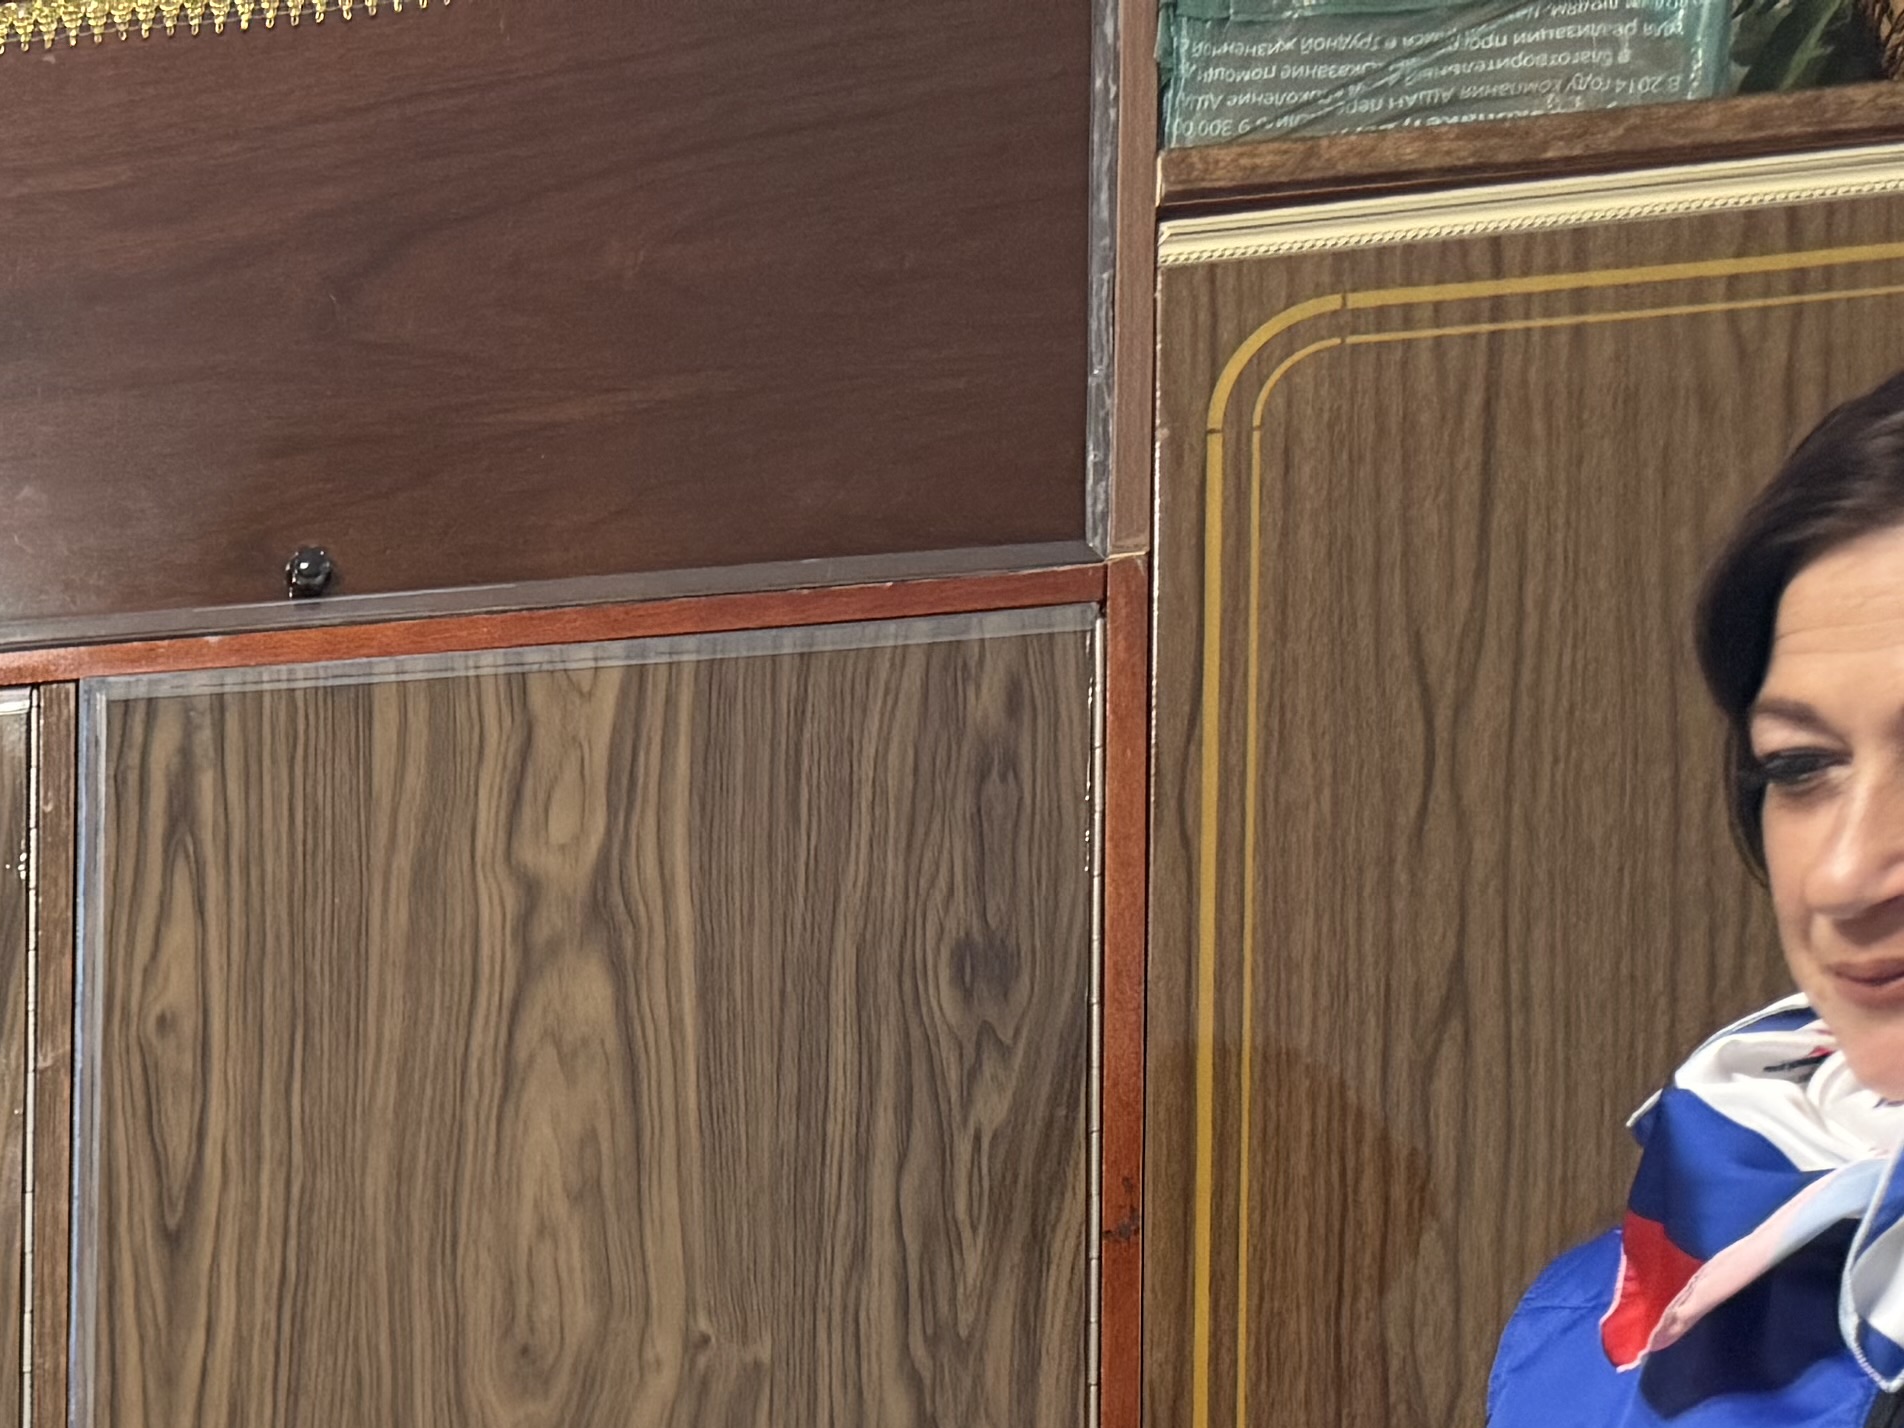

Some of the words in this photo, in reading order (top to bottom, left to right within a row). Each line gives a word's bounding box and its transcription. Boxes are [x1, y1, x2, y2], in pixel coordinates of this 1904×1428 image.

[1458, 78, 1562, 99] компания
[1564, 73, 1612, 94] году
[1615, 76, 1663, 95] 2014
[1388, 86, 1457, 110] АШАН
[1197, 118, 1234, 137] 300
